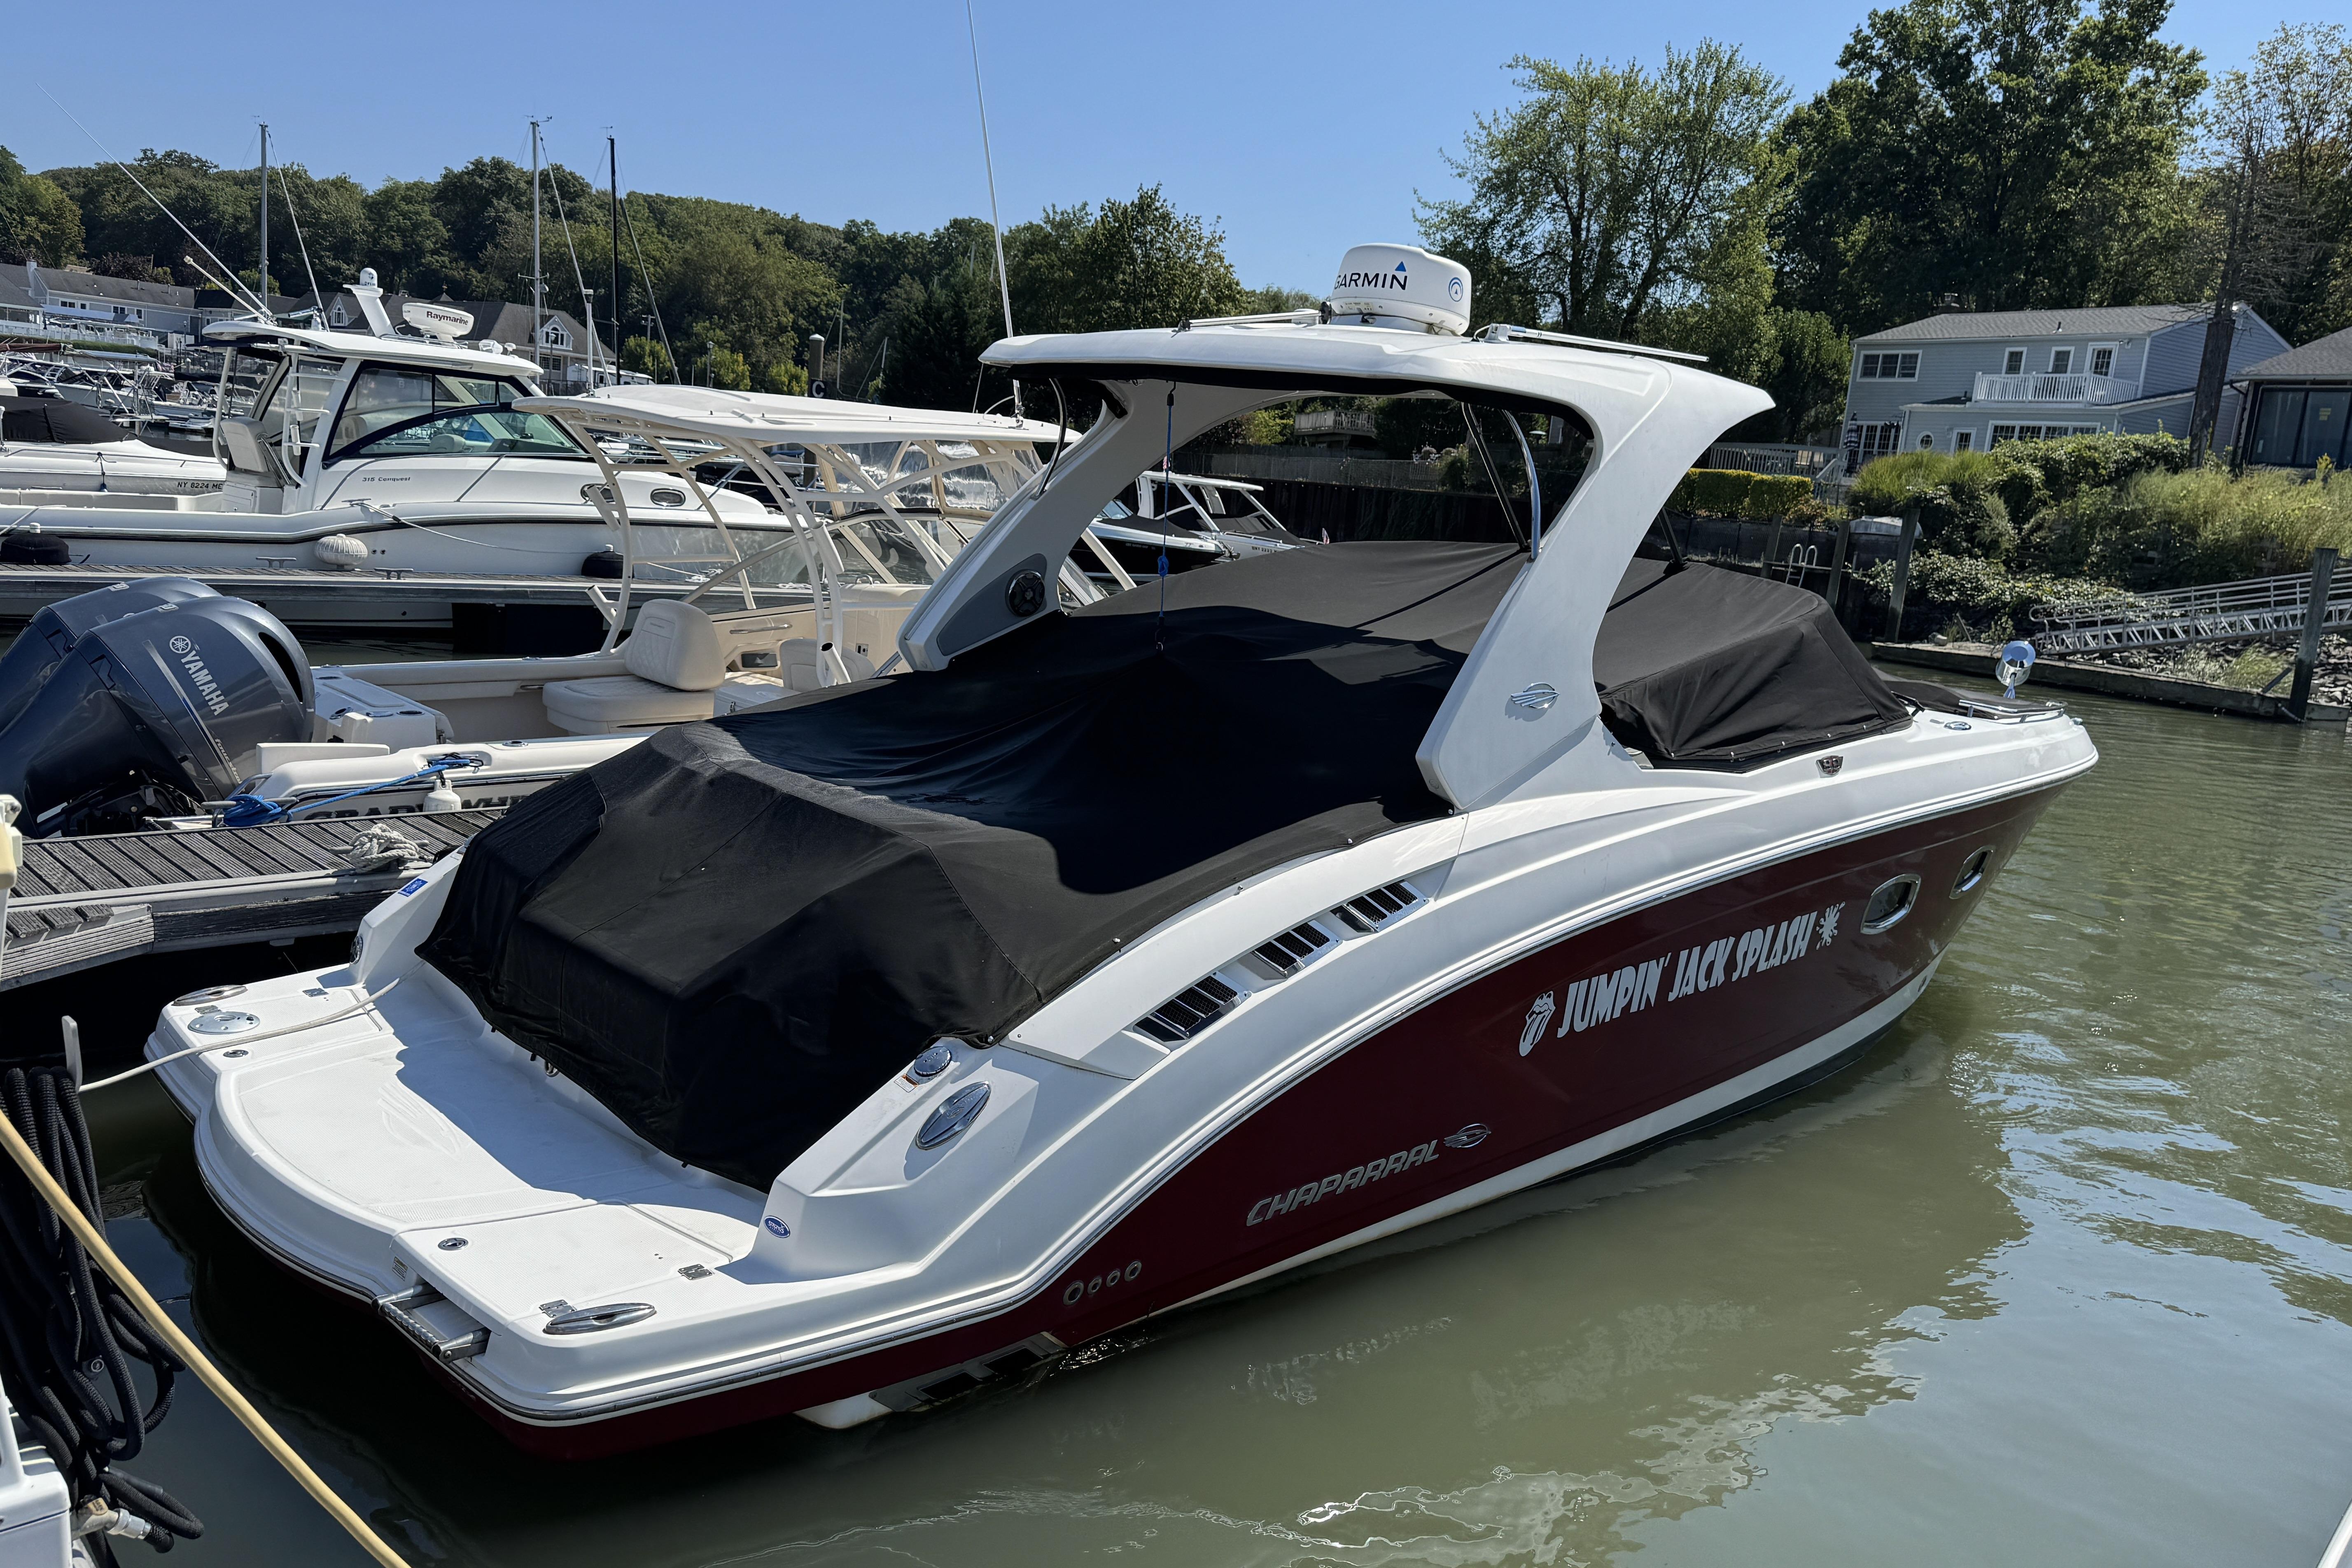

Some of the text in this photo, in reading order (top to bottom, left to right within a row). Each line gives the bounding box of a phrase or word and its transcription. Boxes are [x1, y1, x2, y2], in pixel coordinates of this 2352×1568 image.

[1334, 272, 1408, 290] GARMIN
[427, 311, 469, 325] Raymarine
[812, 381, 825, 398] C
[181, 650, 229, 716] YAMAHA
[1557, 910, 1818, 1038] JUMPIN' JACK SPLASH
[1246, 1139, 1439, 1226] CHAPARRAL
